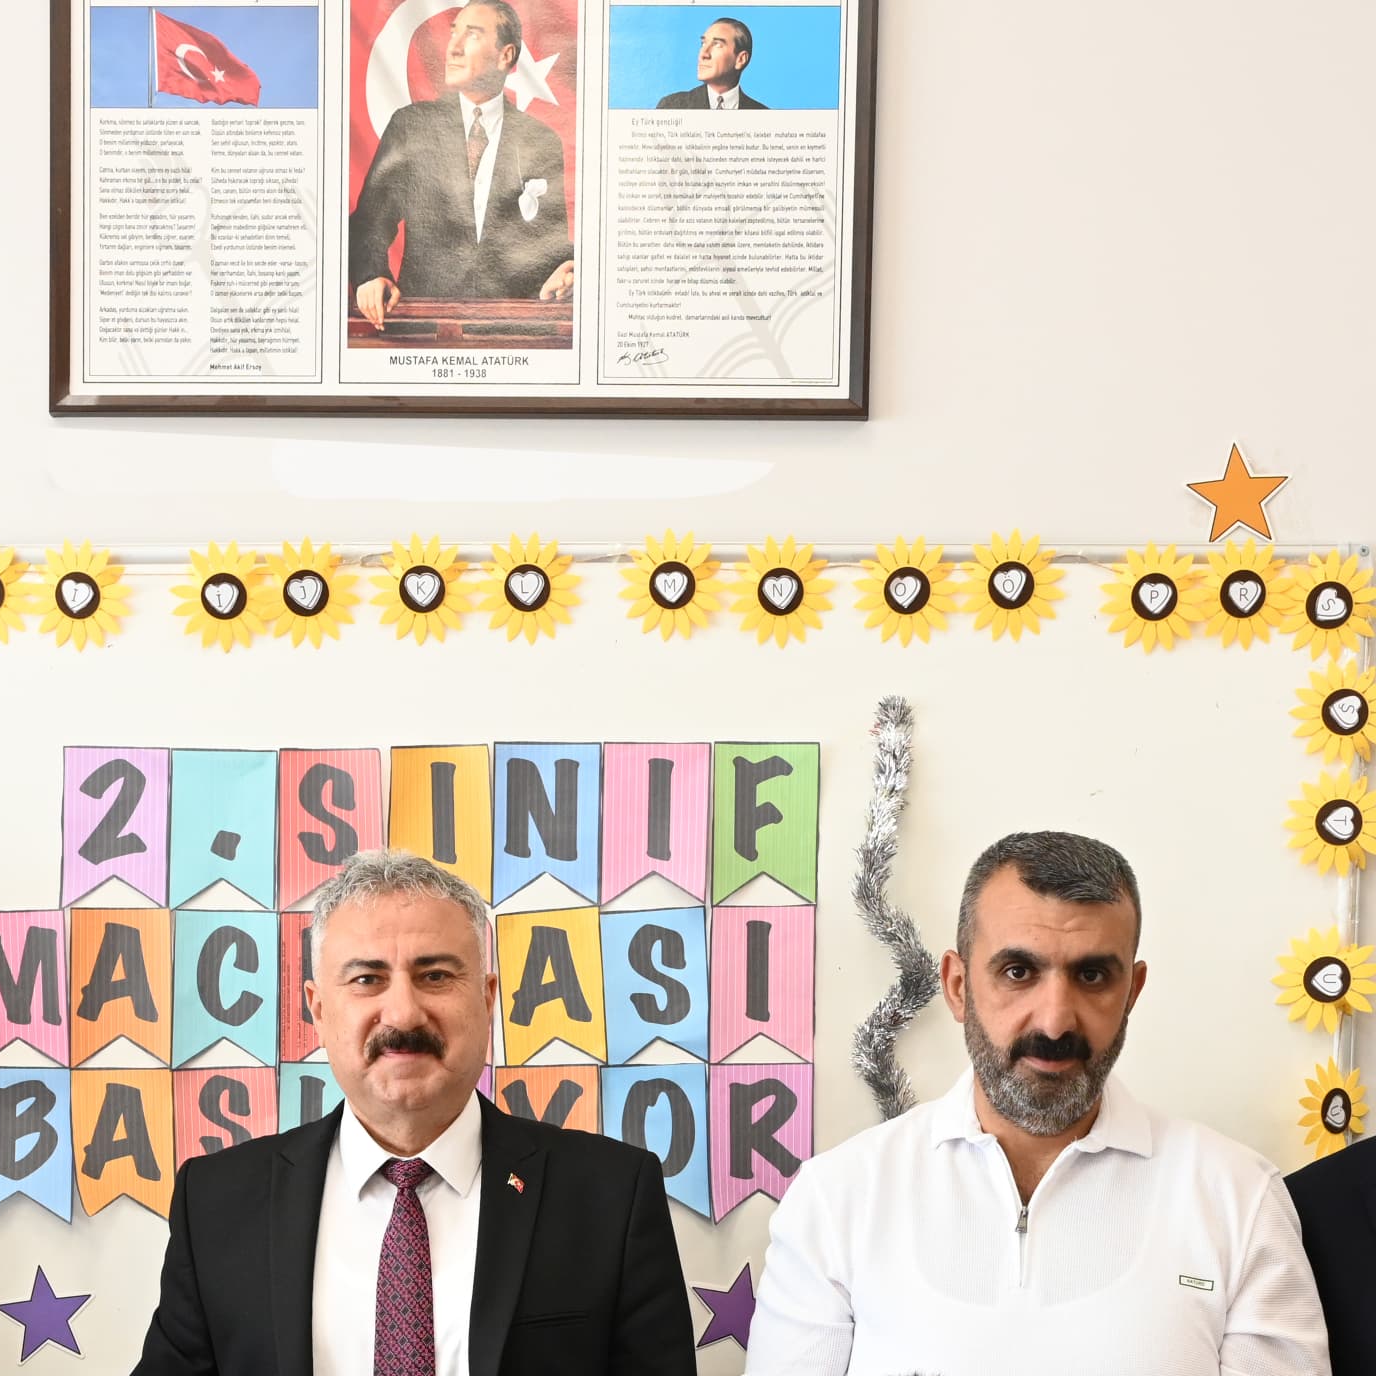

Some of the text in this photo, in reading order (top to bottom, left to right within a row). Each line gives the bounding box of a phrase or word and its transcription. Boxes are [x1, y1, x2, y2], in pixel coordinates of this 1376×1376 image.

[640, 118, 655, 126] Türk
[389, 354, 529, 366] MUSTAFA KEMAL ATATÜRK
[432, 368, 454, 378] 1881
[464, 368, 487, 378] 1938
[416, 581, 426, 595] K
[520, 581, 529, 594] L
[664, 578, 676, 593] M
[772, 584, 783, 598] N
[894, 582, 906, 597] O
[1149, 589, 1159, 604] P
[1239, 587, 1248, 602] R
[295, 754, 795, 866] SINIF
[1333, 815, 1347, 826] T
